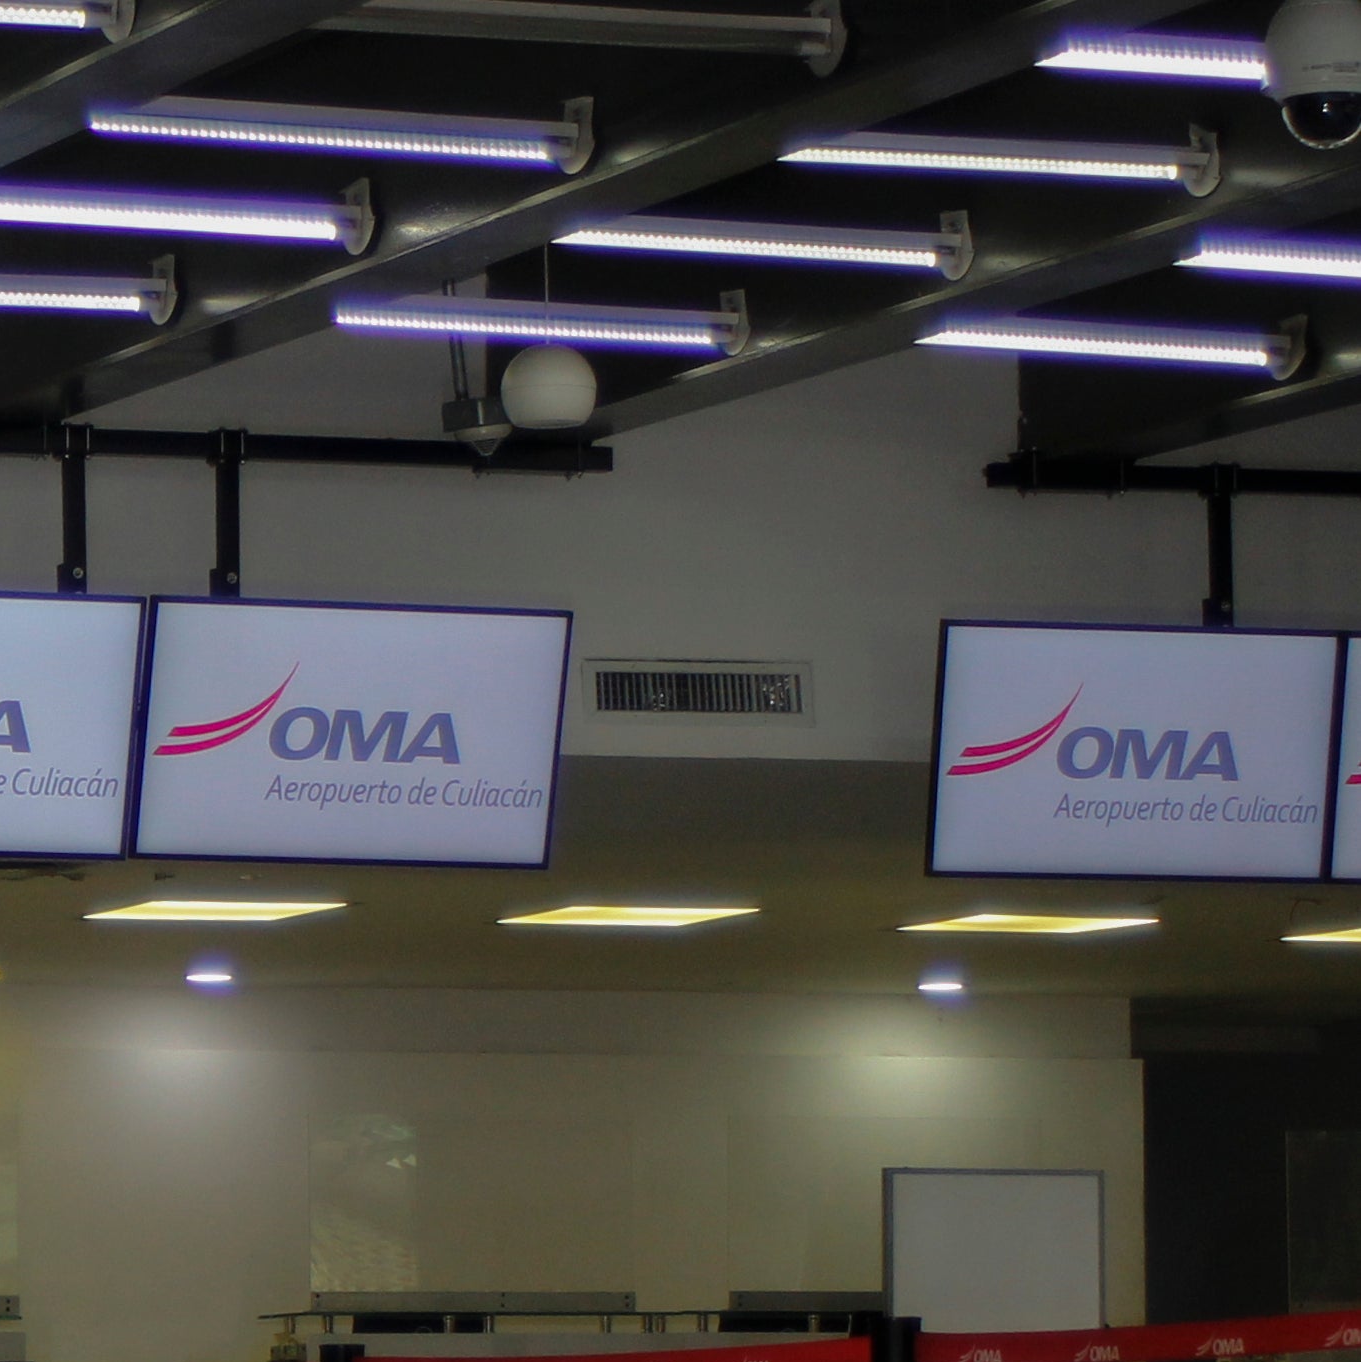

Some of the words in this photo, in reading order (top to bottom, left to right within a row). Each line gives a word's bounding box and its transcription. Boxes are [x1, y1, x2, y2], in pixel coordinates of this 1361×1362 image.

[266, 701, 460, 764] OMA
[1057, 727, 1238, 781] OMA
[12, 768, 118, 797] Culiacán
[265, 775, 401, 810] Aeropuerto
[408, 777, 437, 805] de
[442, 779, 543, 808] Culiacán
[1053, 794, 1183, 827] Aeropuerto
[1190, 794, 1217, 821] de
[1222, 796, 1318, 823] Culiacán
[1089, 1345, 1120, 1362] OMA
[1212, 1338, 1244, 1356] OMA
